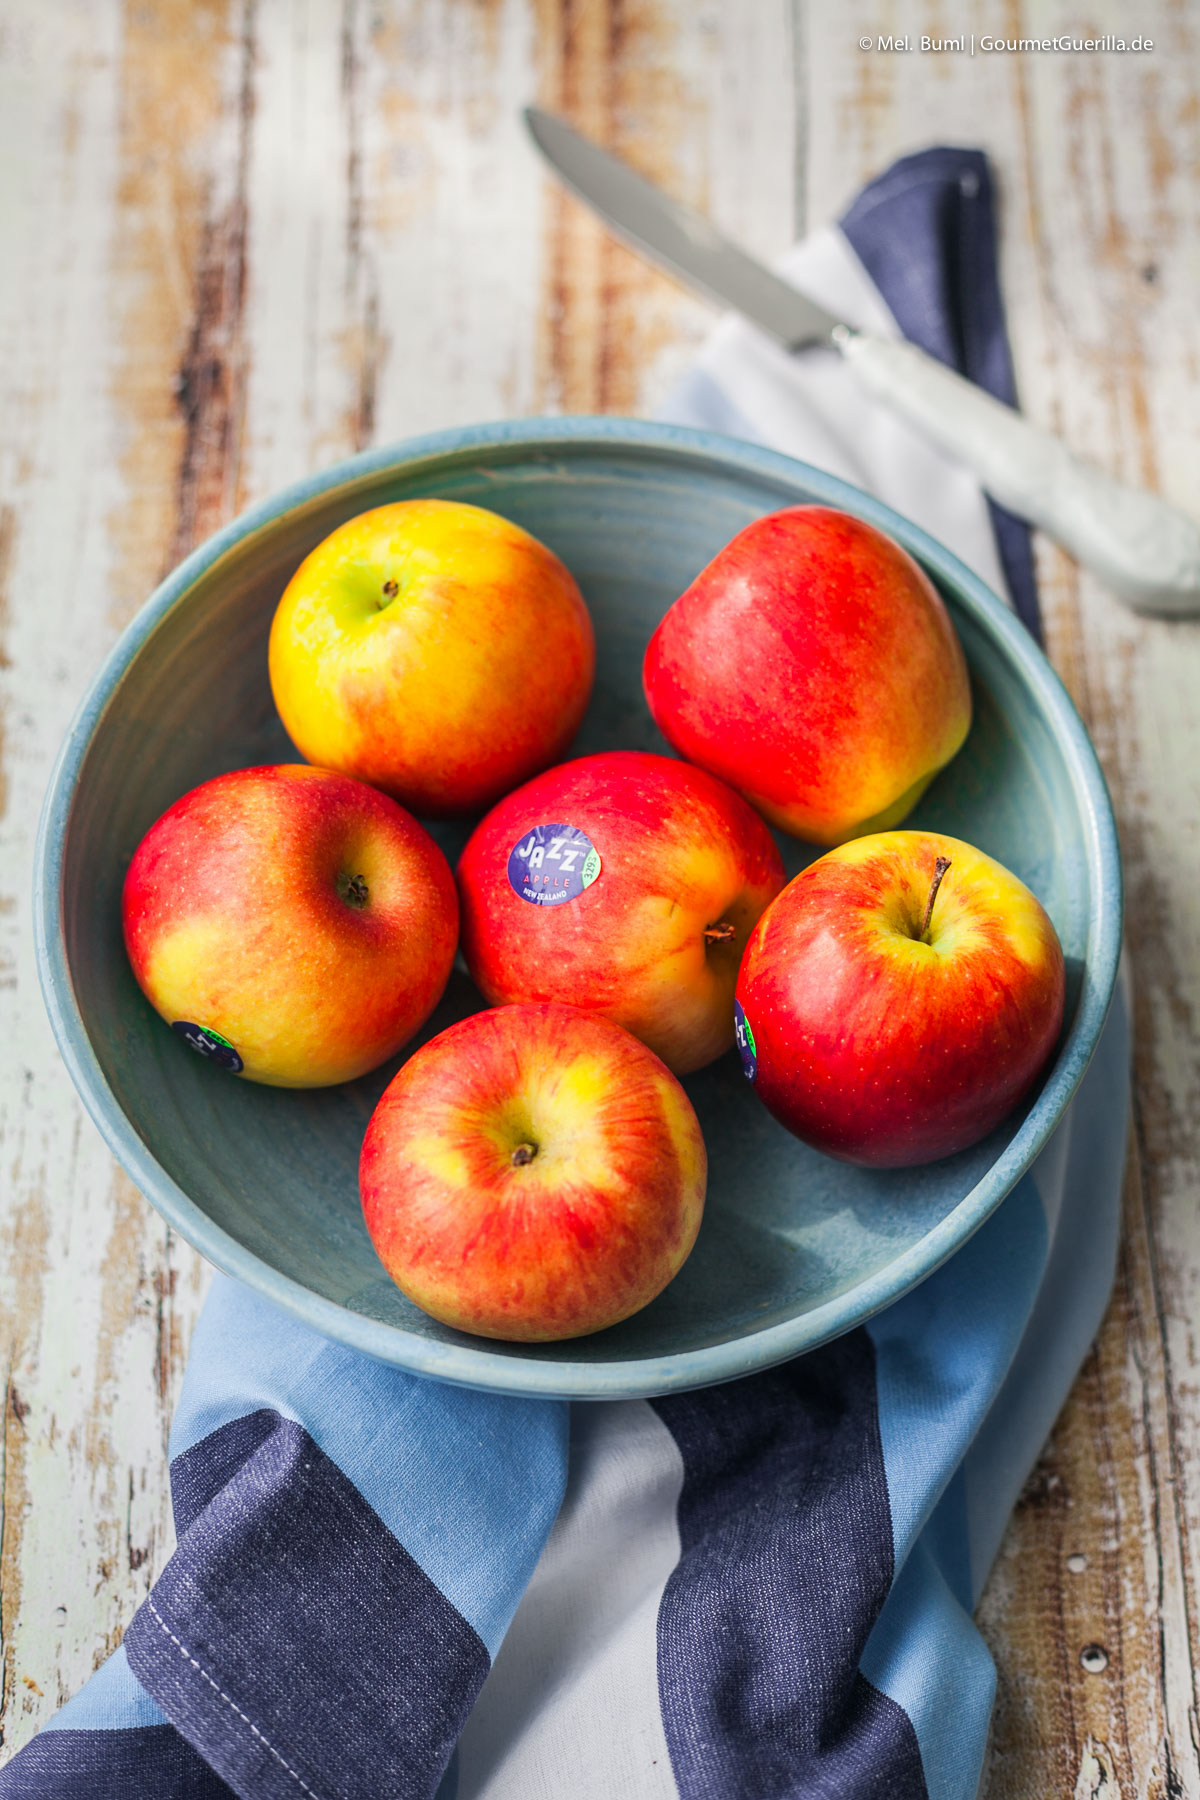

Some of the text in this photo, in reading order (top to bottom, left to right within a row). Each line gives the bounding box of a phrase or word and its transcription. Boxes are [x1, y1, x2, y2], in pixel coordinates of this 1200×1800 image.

[523, 874, 571, 888] APPLE
[523, 887, 567, 901] NEW ZEALAND
